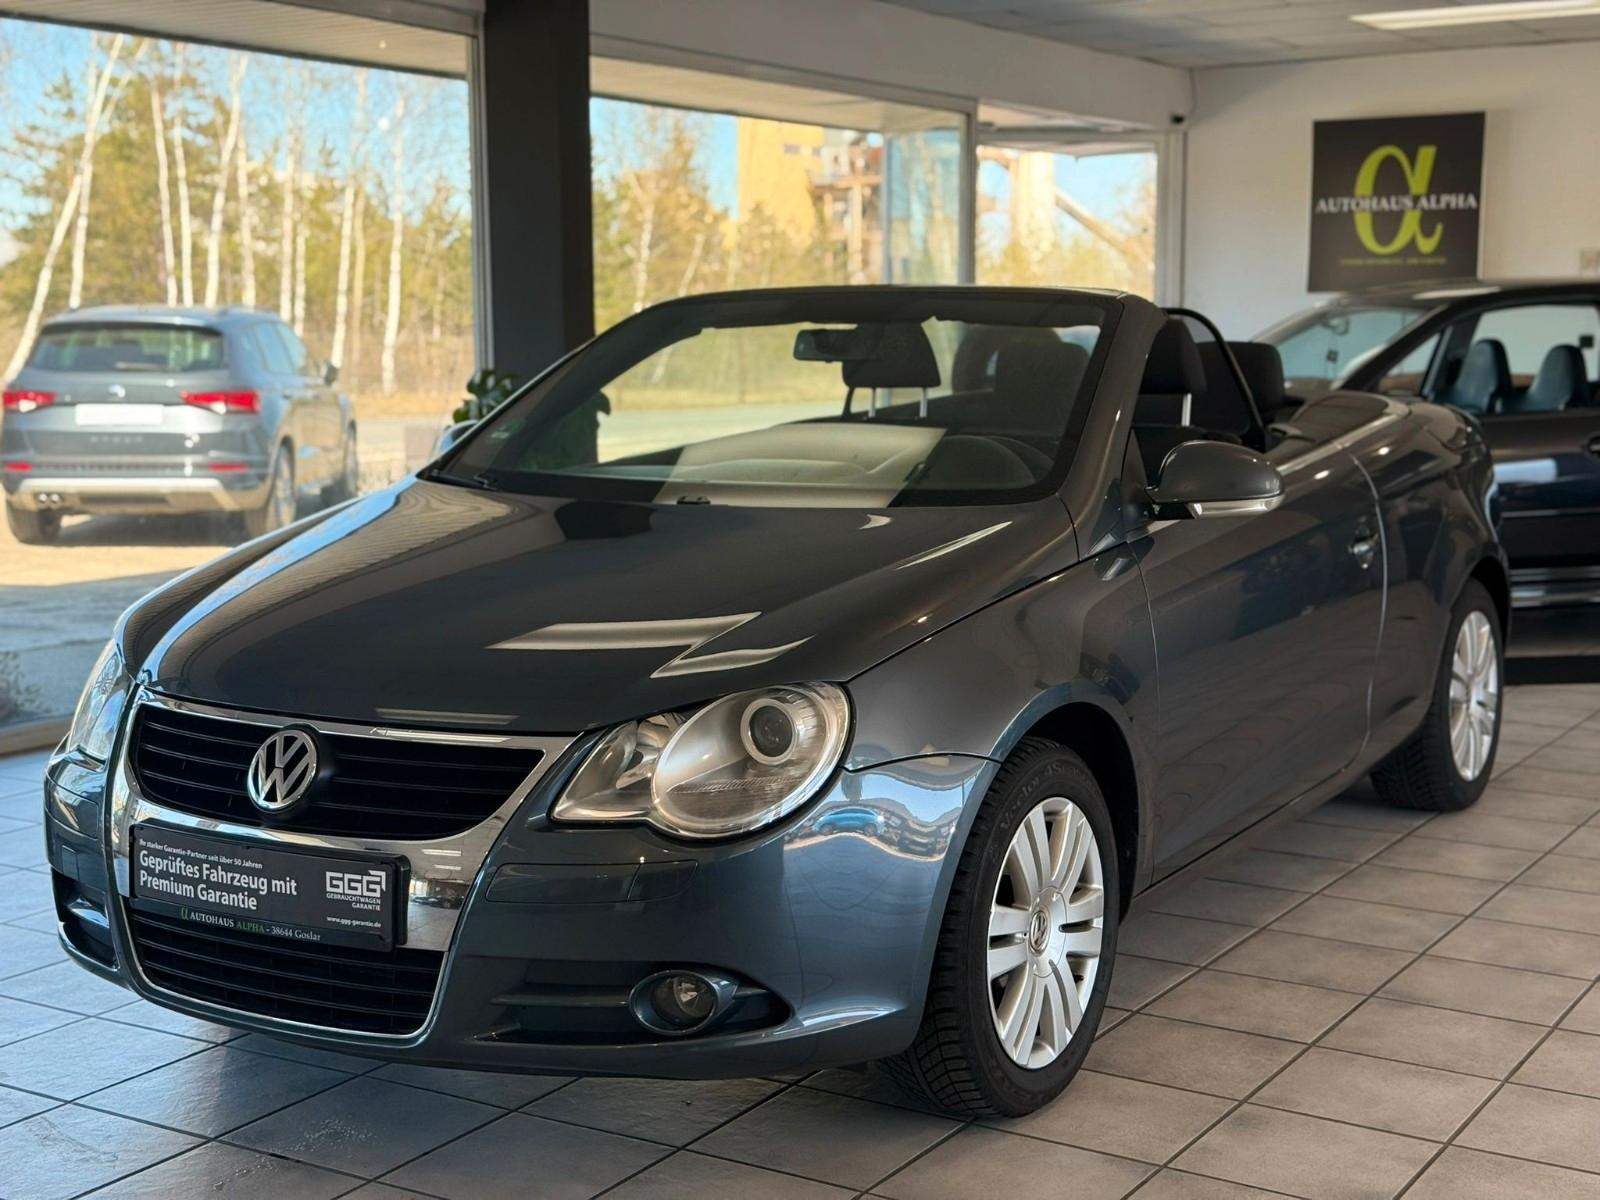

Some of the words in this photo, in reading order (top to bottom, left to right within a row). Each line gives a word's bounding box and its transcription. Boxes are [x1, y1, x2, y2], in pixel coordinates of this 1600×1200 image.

[1315, 194, 1413, 213] AUTOHAUS
[1416, 192, 1478, 210] ALPHA
[147, 841, 164, 852] starker
[164, 845, 207, 860] Garantie-Partner
[208, 854, 219, 862] seit
[219, 855, 233, 865] über
[234, 858, 242, 866] 50
[242, 860, 263, 869] Jahren
[140, 850, 200, 879] Geprüftes
[202, 863, 268, 895] Fahrzeug
[271, 876, 298, 896] mit
[325, 870, 386, 898] GGG
[140, 870, 195, 898] Premium
[197, 884, 258, 910] Garantie
[325, 892, 381, 905] GEBRAUCHTWAGEN
[351, 902, 381, 911] GARANTIE
[190, 912, 235, 928] AUTOHAUS
[237, 921, 265, 934] ALPHA
[271, 925, 293, 937] 38644
[294, 929, 321, 941] Goslar
